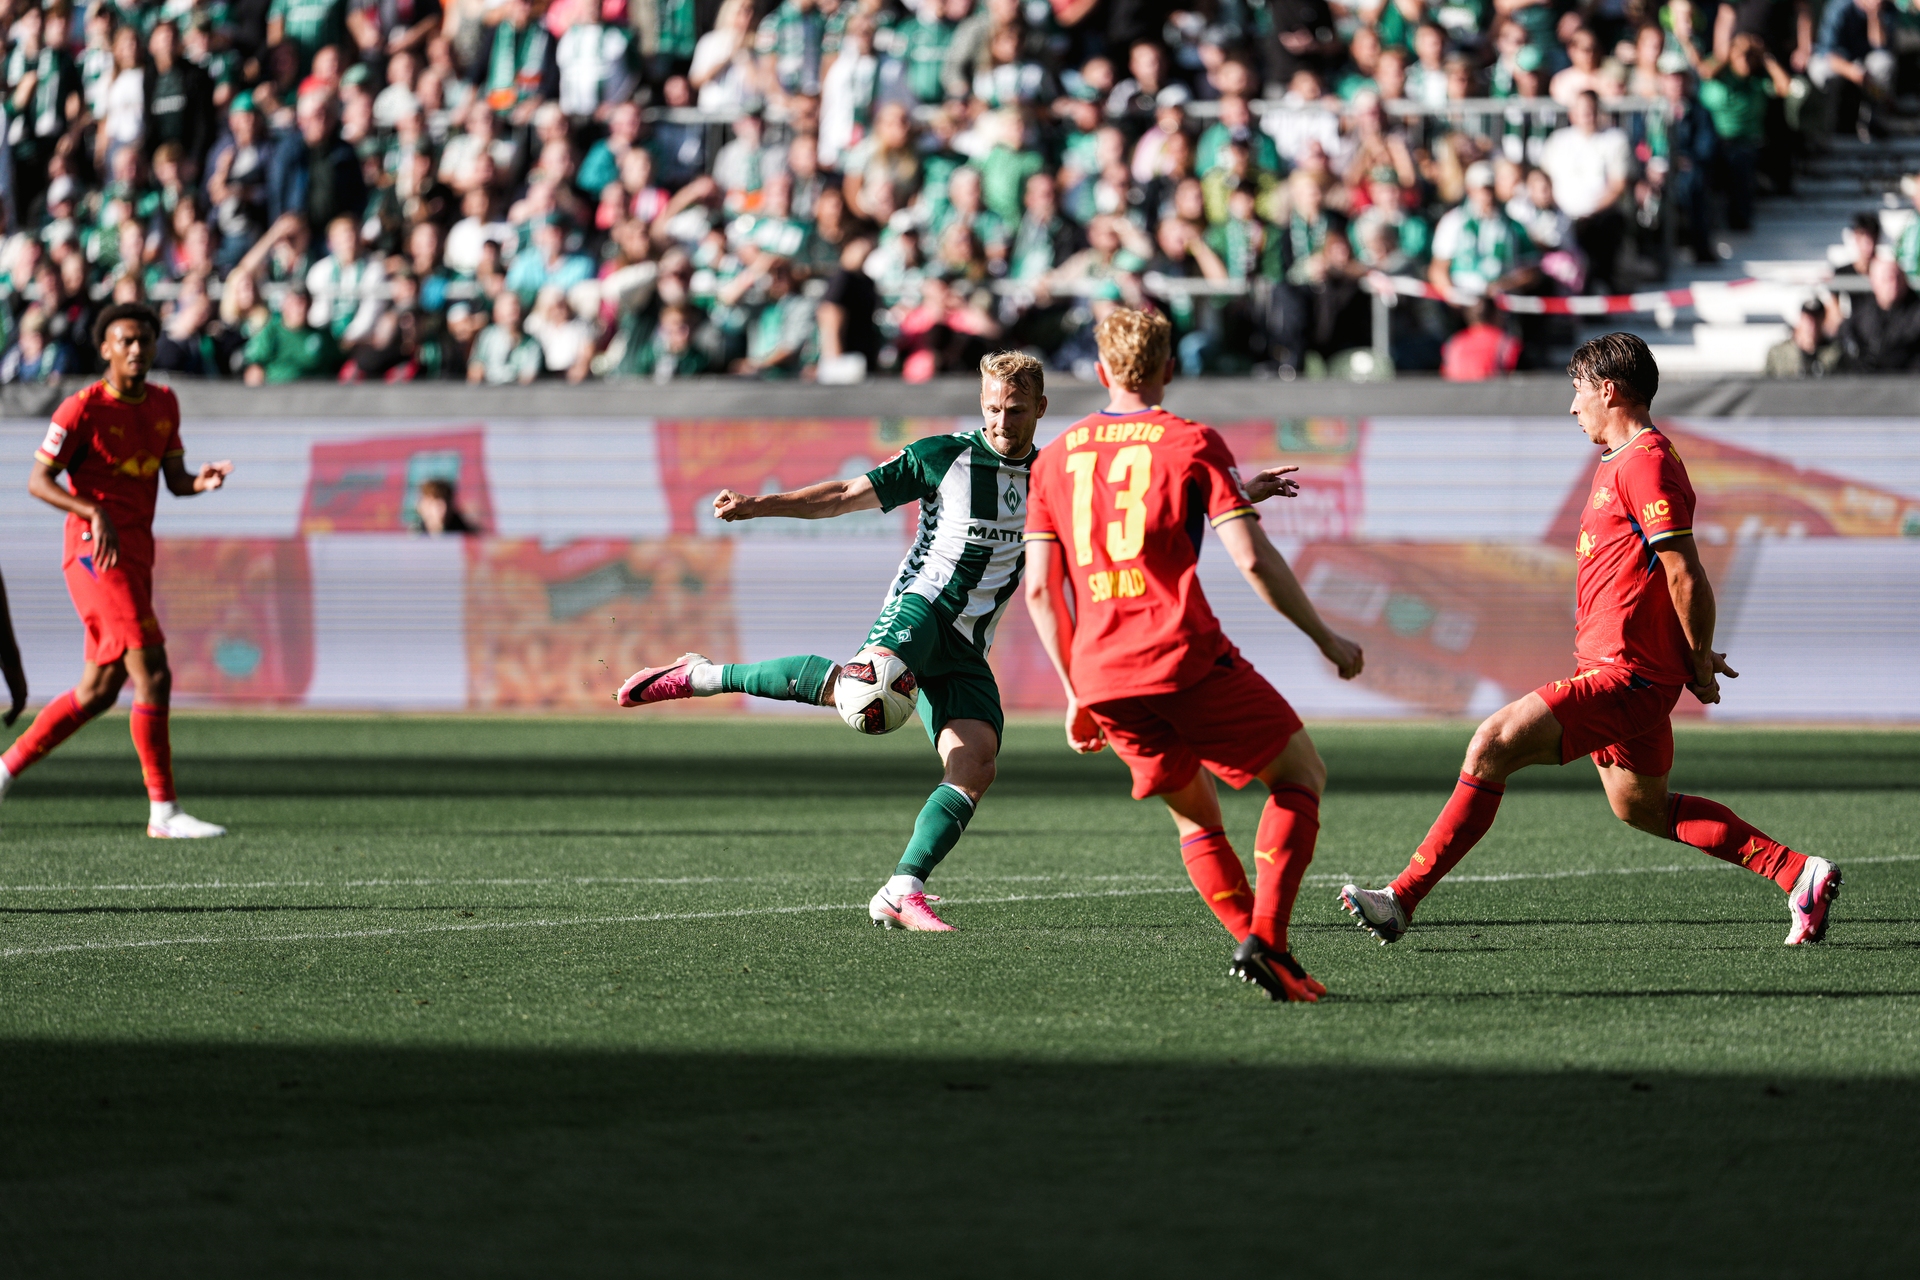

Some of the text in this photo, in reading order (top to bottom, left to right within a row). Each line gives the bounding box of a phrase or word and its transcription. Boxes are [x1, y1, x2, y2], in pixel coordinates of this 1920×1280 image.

[1065, 422, 1166, 452] RB LEIPZIG
[1065, 444, 1153, 567] 13
[1412, 851, 1426, 867] RBL
